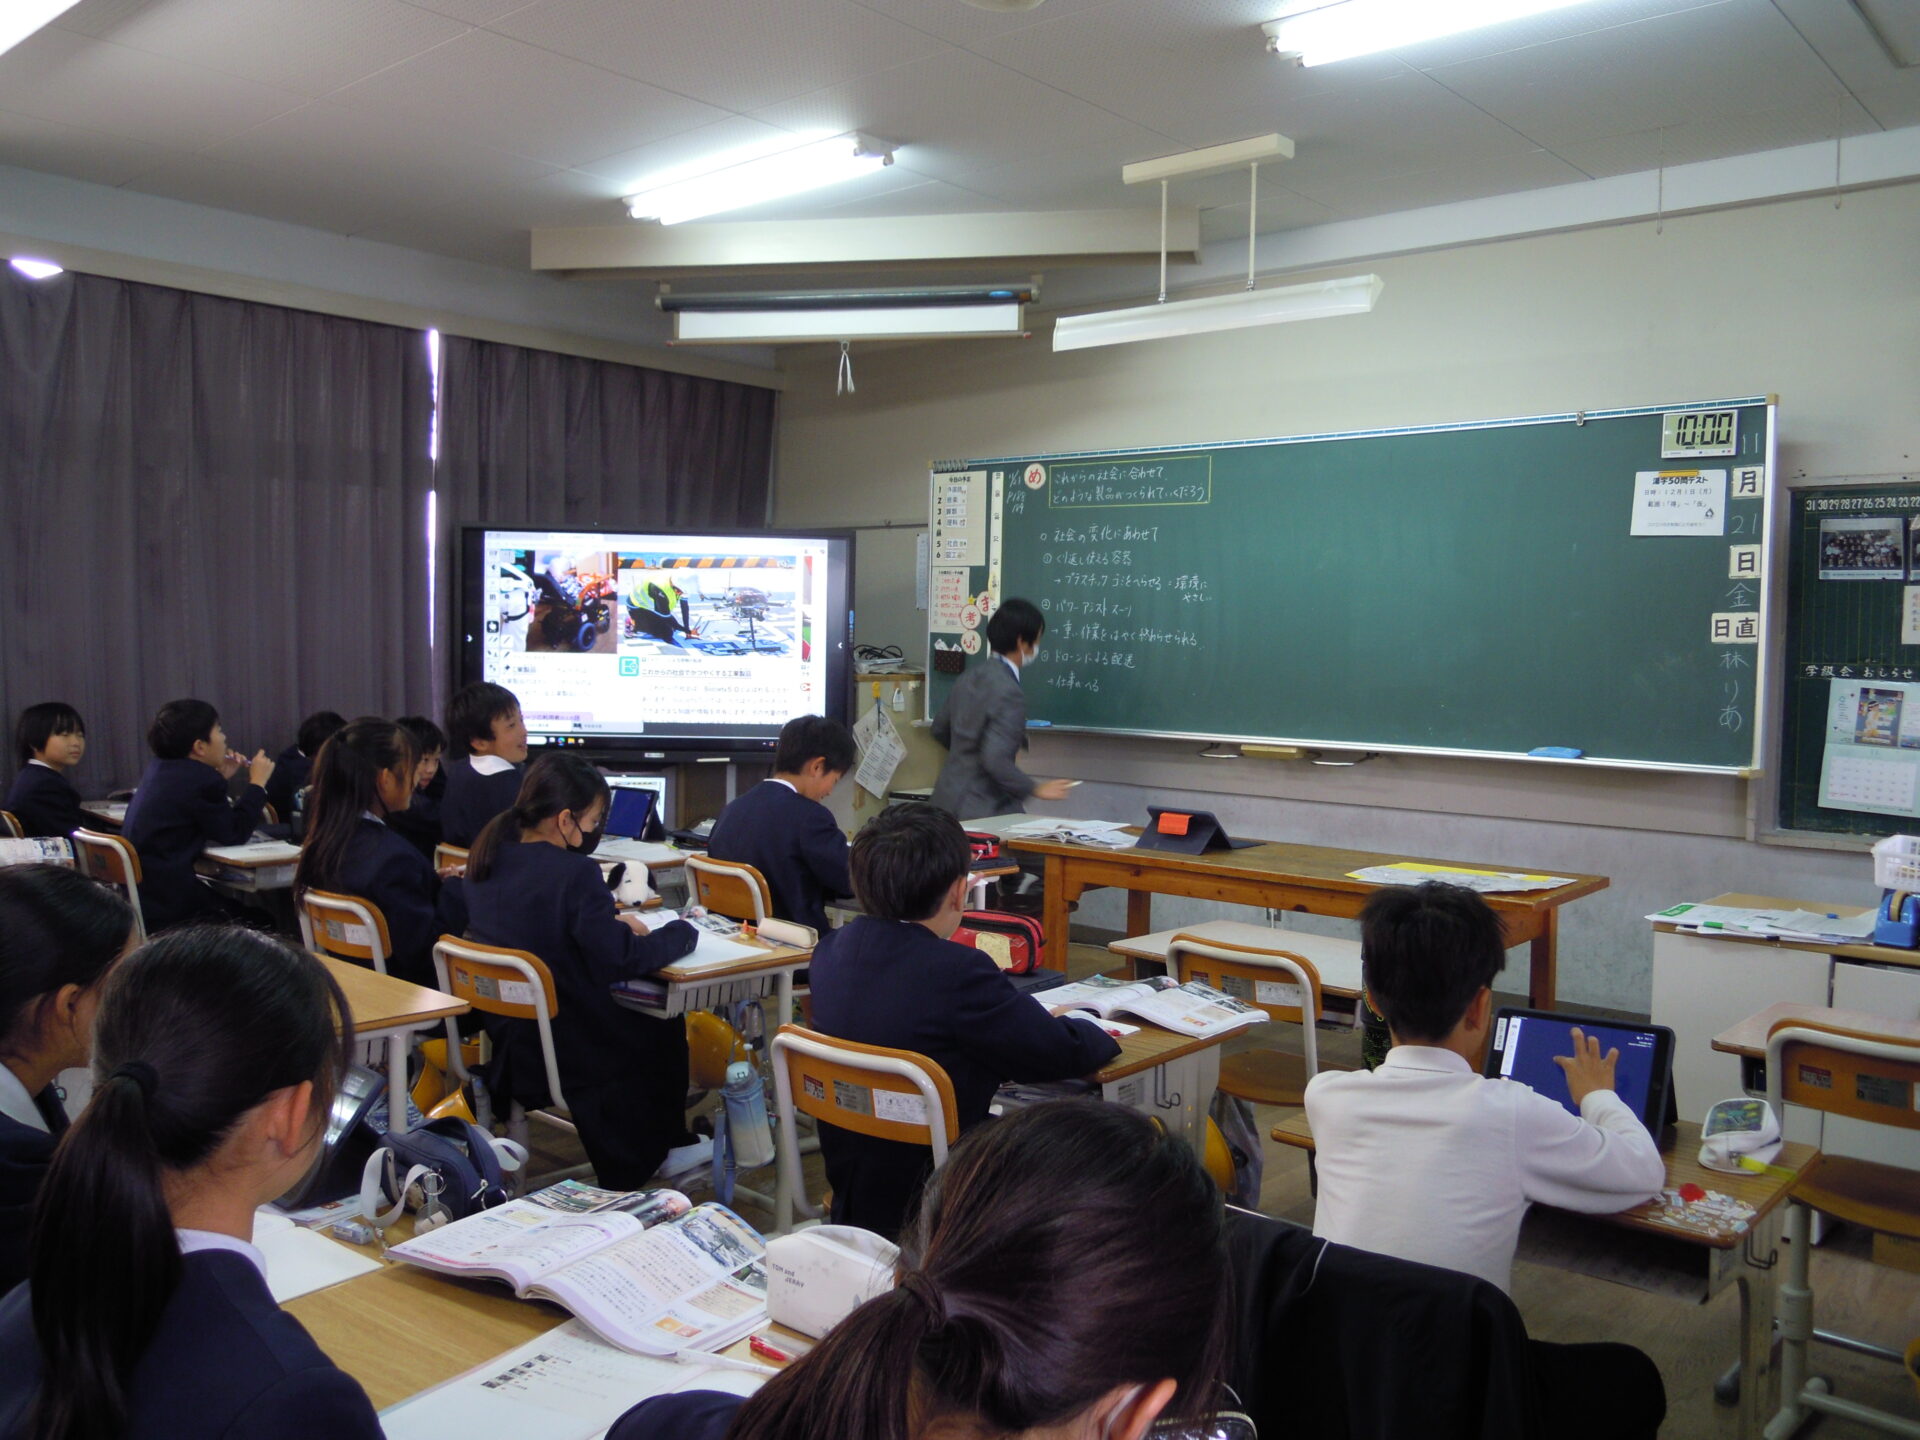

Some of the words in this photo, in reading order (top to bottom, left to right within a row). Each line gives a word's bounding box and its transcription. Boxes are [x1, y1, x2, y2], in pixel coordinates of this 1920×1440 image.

[1676, 413, 1733, 446] 10:00
[1028, 468, 1042, 485] め
[1738, 470, 1757, 494] 月
[1806, 501, 1816, 511] 31
[1818, 500, 1828, 511] 30
[1829, 500, 1839, 510] 29
[1840, 500, 1851, 510] 28
[1852, 499, 1862, 510] 27
[1863, 499, 1874, 509] 26
[1875, 498, 1886, 509] 25
[1887, 498, 1897, 508] 24
[1898, 497, 1909, 508] 23
[1737, 551, 1755, 573] 日
[1725, 582, 1756, 609] 金
[1714, 617, 1757, 639] 日直
[1805, 664, 1854, 678] 学級会
[1863, 666, 1914, 679] おしらせ
